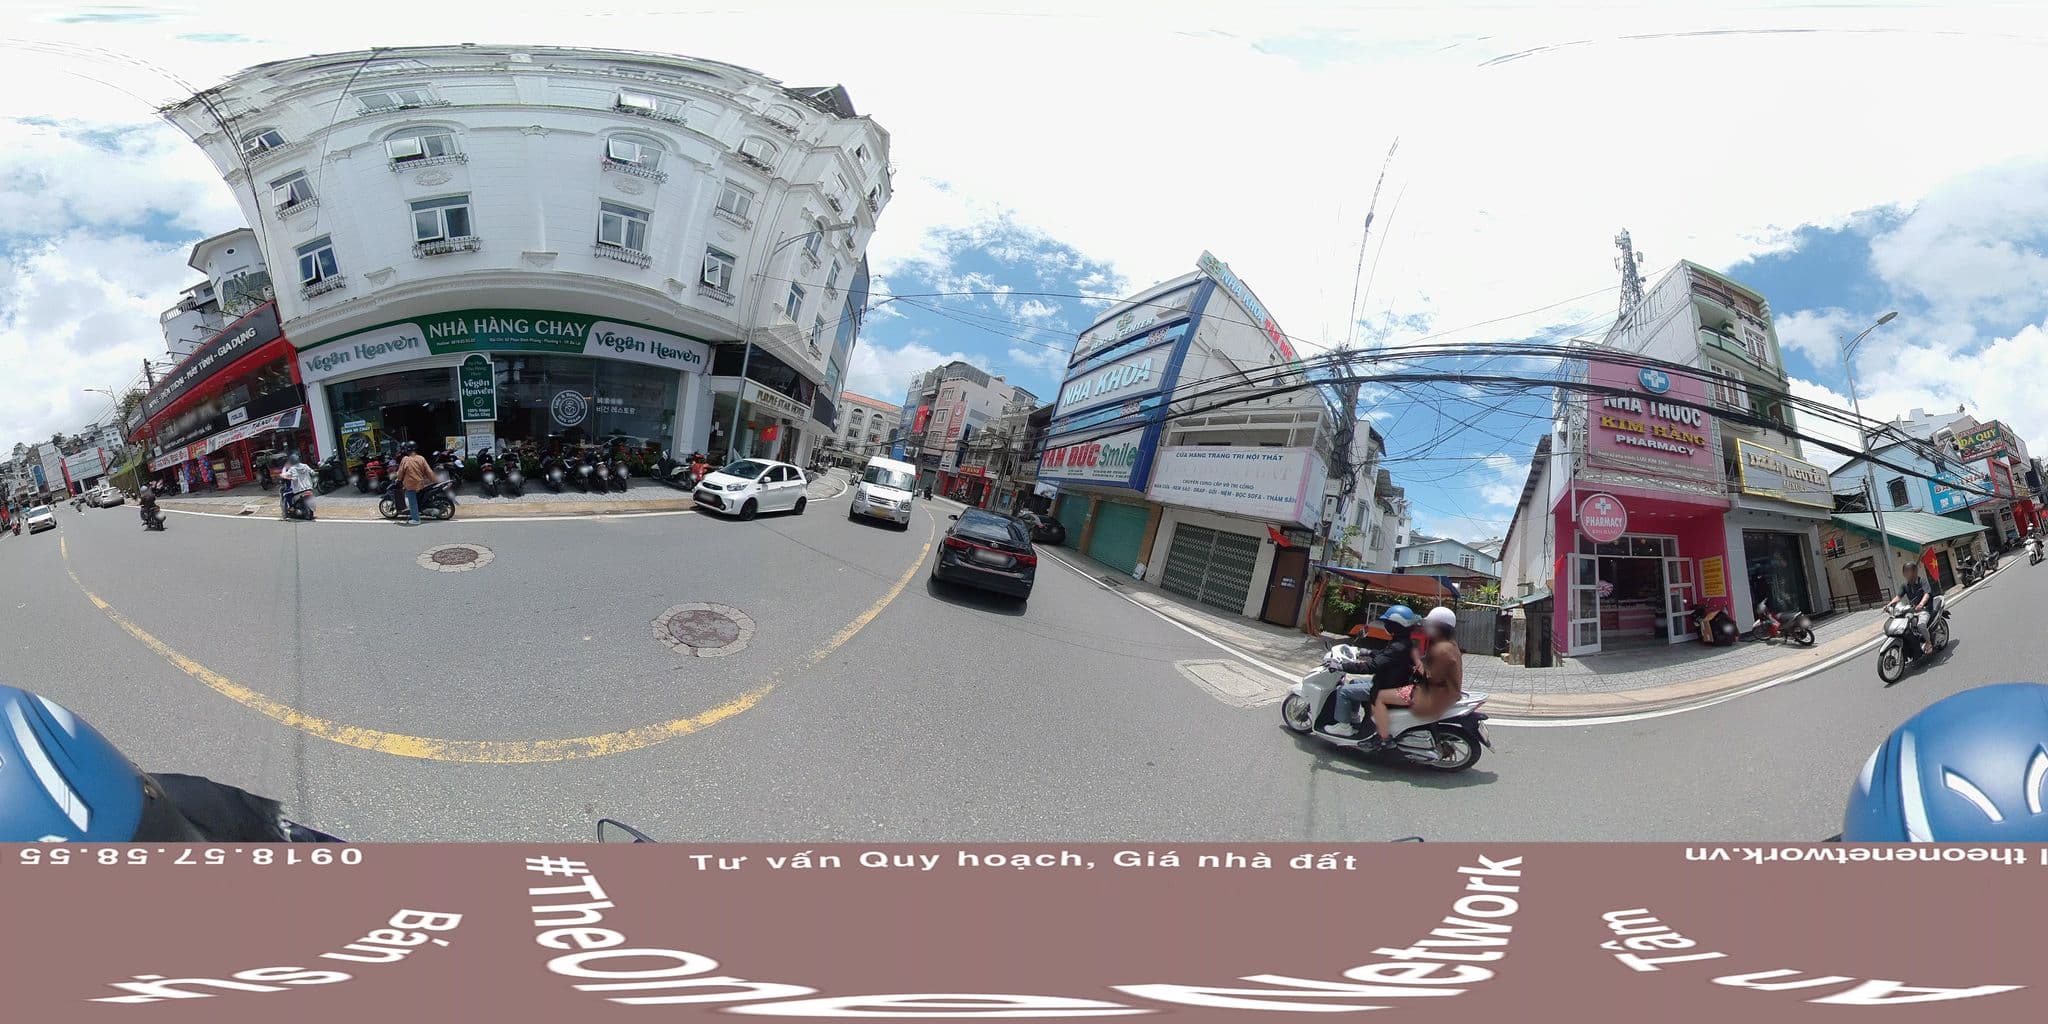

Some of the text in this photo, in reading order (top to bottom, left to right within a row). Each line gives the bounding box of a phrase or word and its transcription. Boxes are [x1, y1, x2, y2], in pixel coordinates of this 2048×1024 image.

[1221, 270, 1242, 298] NHA
[1243, 293, 1265, 322] KHOA
[429, 316, 587, 338] NHÀ HÀNG CHAY
[217, 342, 232, 357] GIA
[230, 327, 257, 347] DỤNG
[595, 331, 701, 365] Vegan Heaven
[305, 351, 350, 372] Vegan
[355, 336, 419, 359] Heaven
[462, 387, 493, 397] Heaven
[463, 379, 490, 388] Vegan
[1062, 358, 1152, 408] NHA KHOA
[1601, 416, 1645, 433] KIM
[1099, 442, 1138, 467] Smile
[1616, 434, 1696, 456] PHARMACY
[1246, 453, 1260, 462] NỘI
[1585, 515, 1623, 528] PHARMACY
